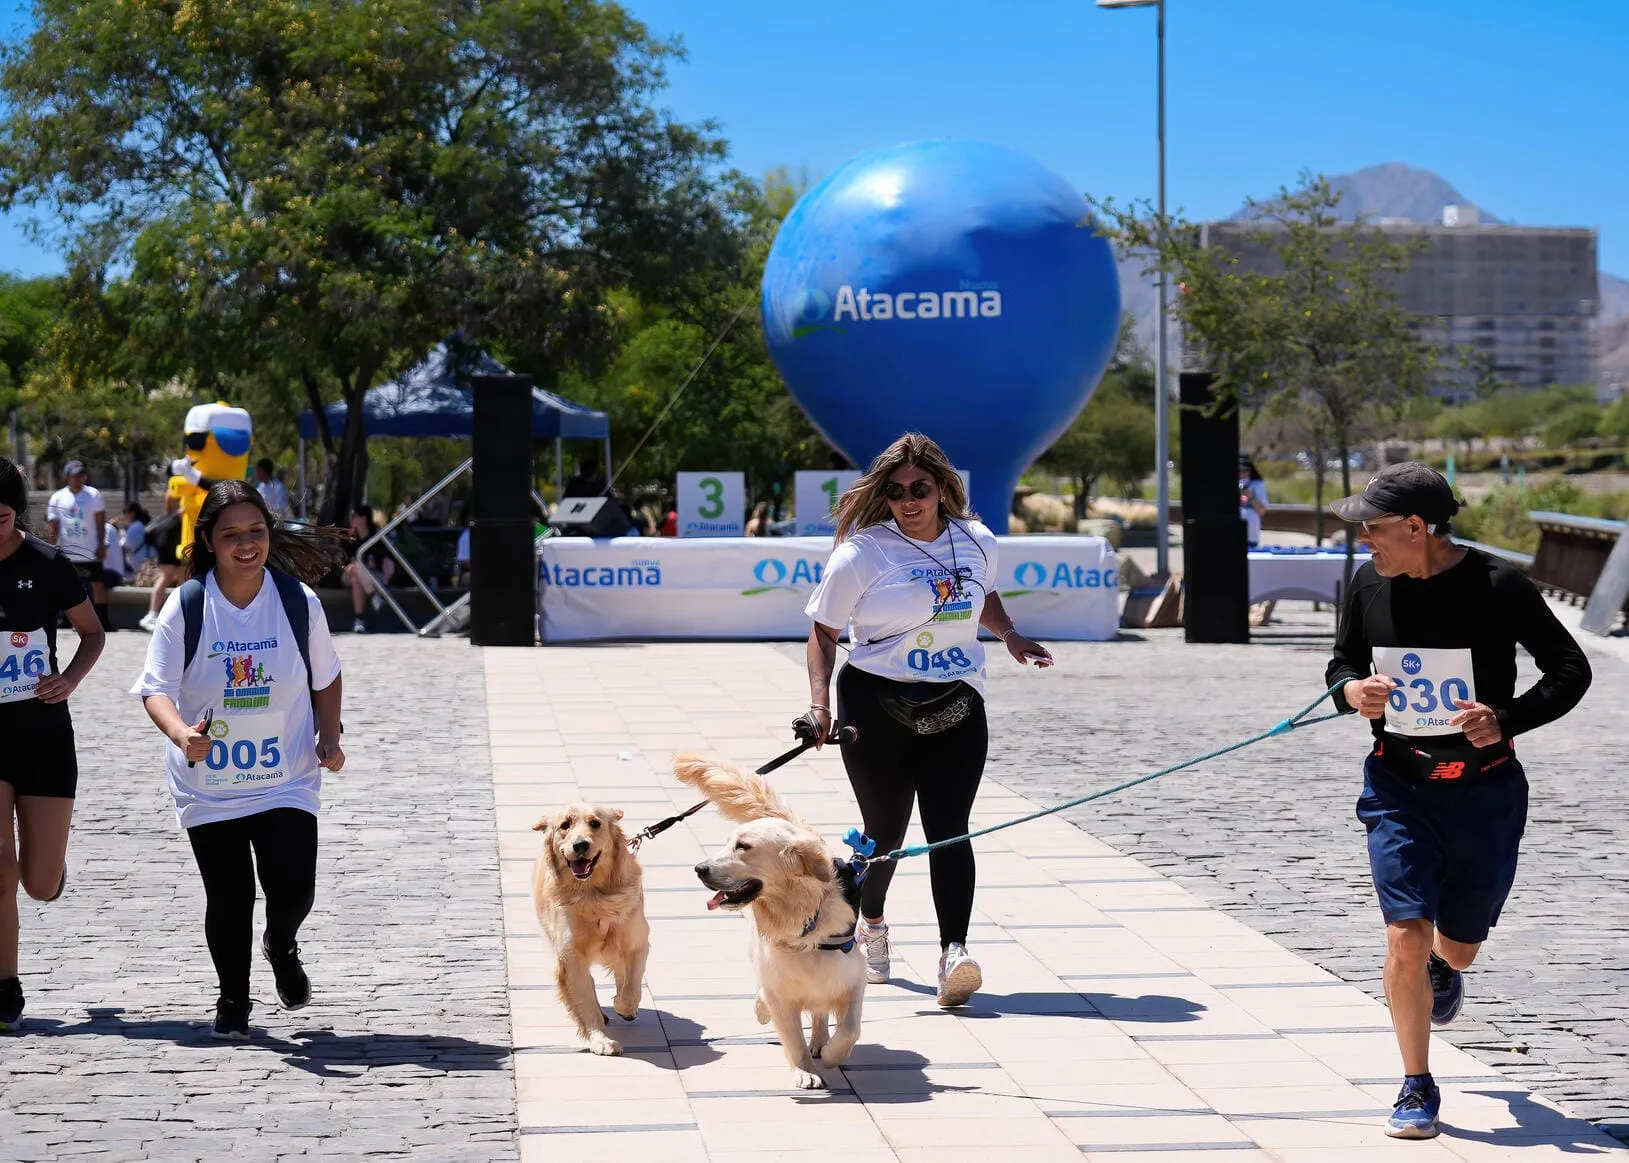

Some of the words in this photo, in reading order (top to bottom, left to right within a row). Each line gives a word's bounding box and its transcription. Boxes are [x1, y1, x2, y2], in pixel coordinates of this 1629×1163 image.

[834, 284, 1002, 321] Atacama
[697, 476, 725, 519] 3
[538, 559, 662, 587] Atacama
[227, 639, 278, 653] Atacama
[907, 646, 972, 671] 048
[0, 649, 45, 682] 46
[1402, 659, 1421, 669] 5K+
[1388, 677, 1469, 713] 630
[205, 736, 281, 771] 005
[246, 770, 283, 782] Atacama
